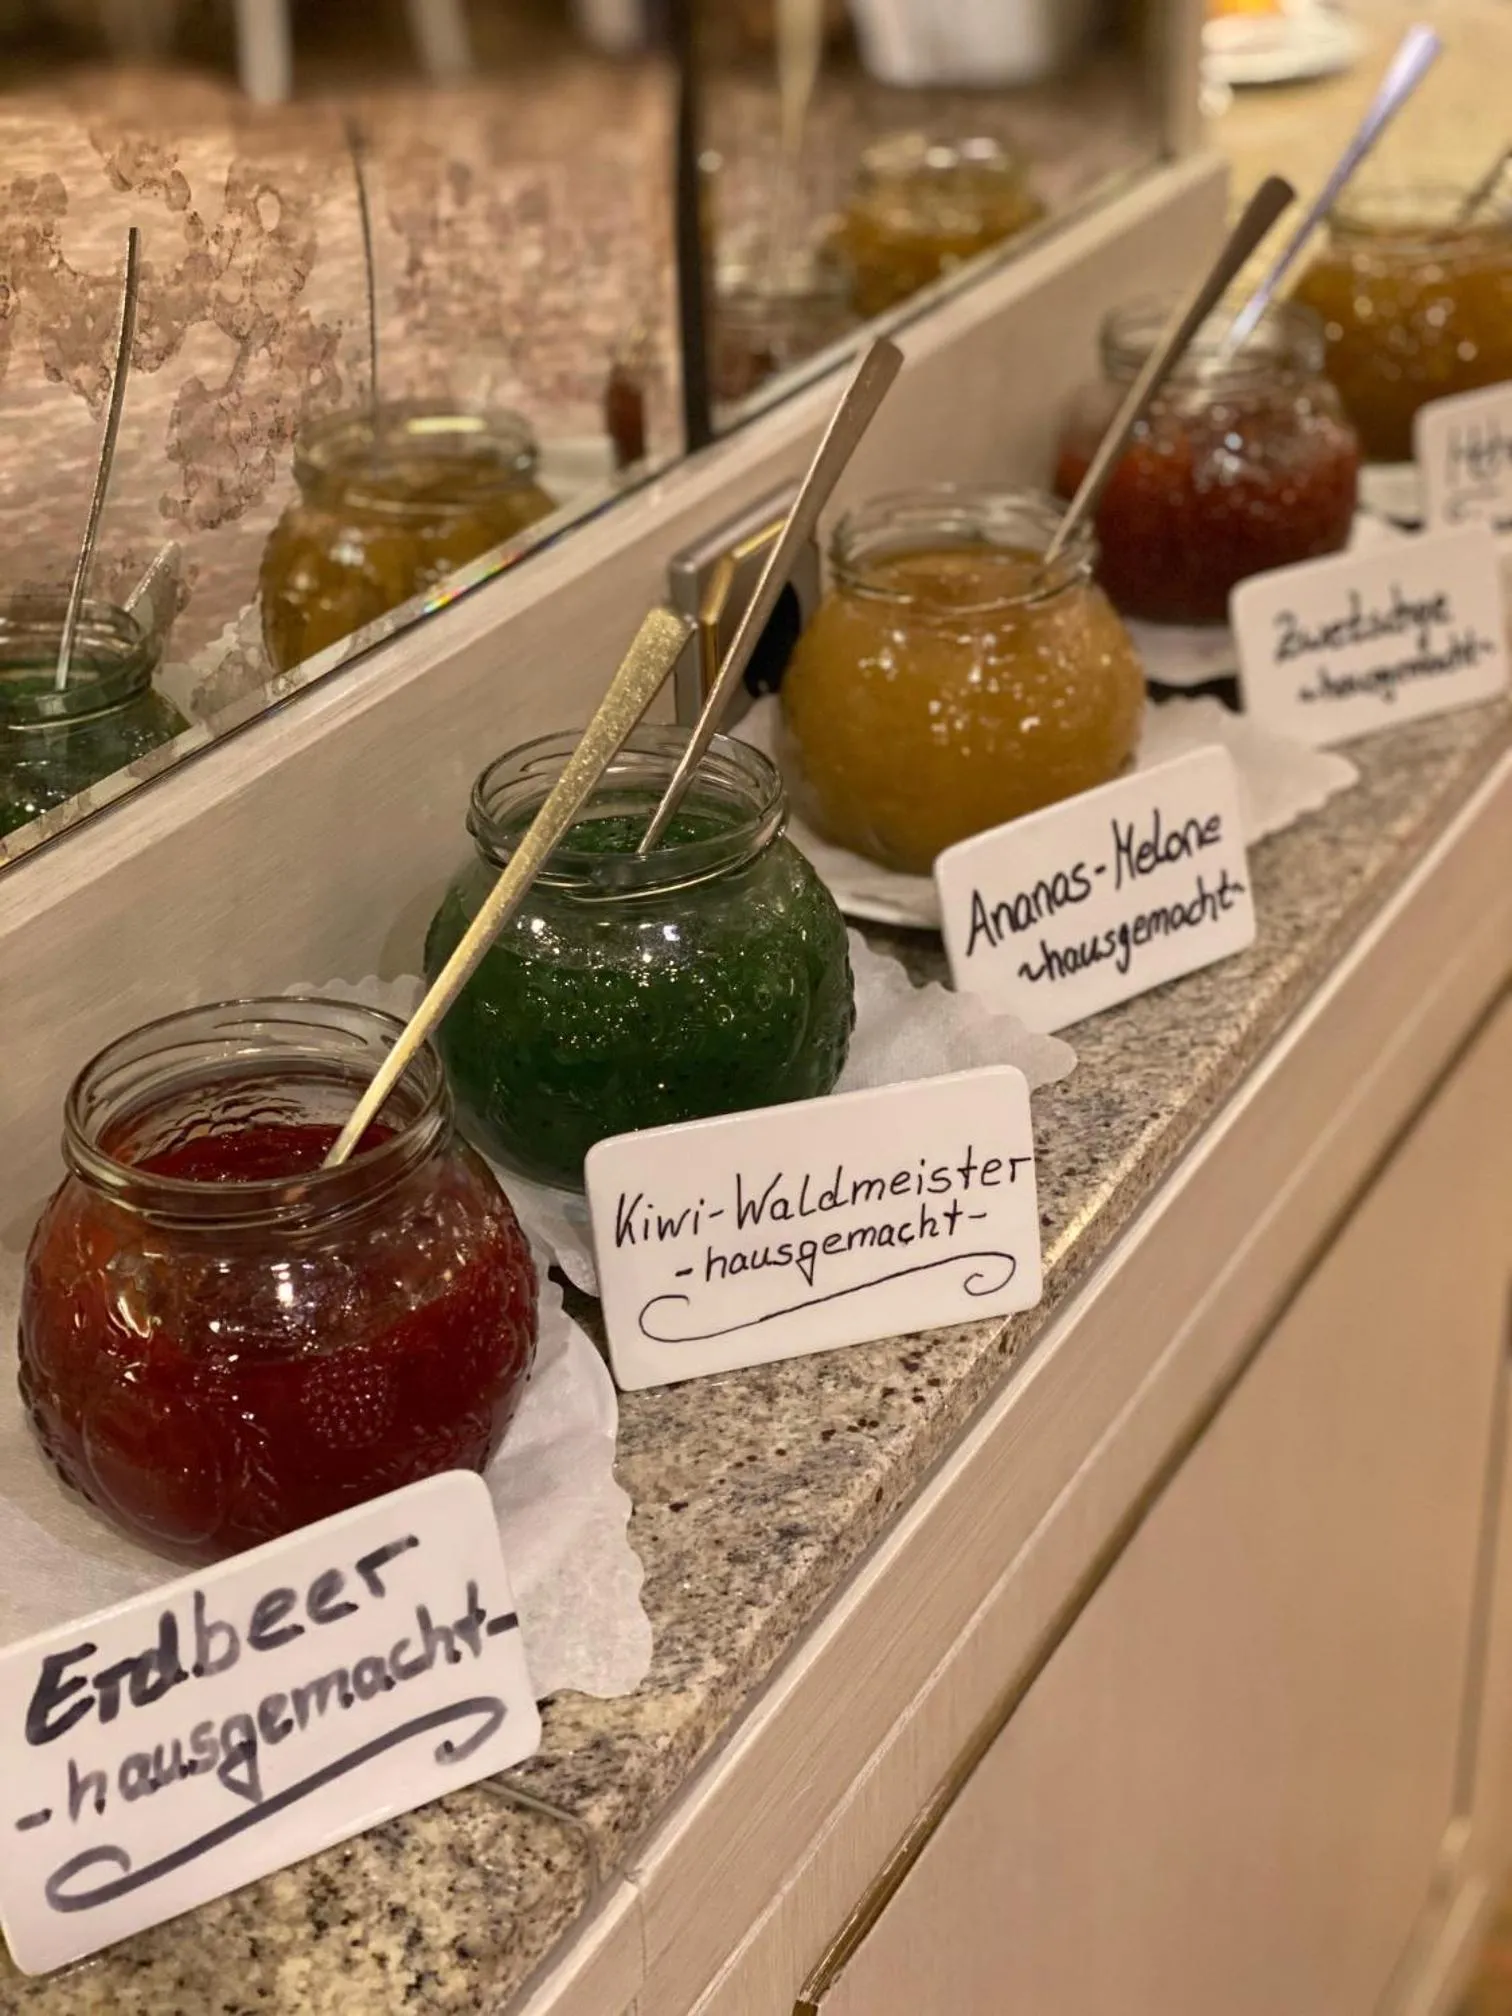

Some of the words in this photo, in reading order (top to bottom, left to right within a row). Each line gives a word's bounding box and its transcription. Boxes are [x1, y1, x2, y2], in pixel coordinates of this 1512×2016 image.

[966, 806, 1223, 957] Ananas-Melone
[614, 1145, 1033, 1248] Kiwi-Waldmeister
[24, 1534, 419, 1746] Erdbeer
